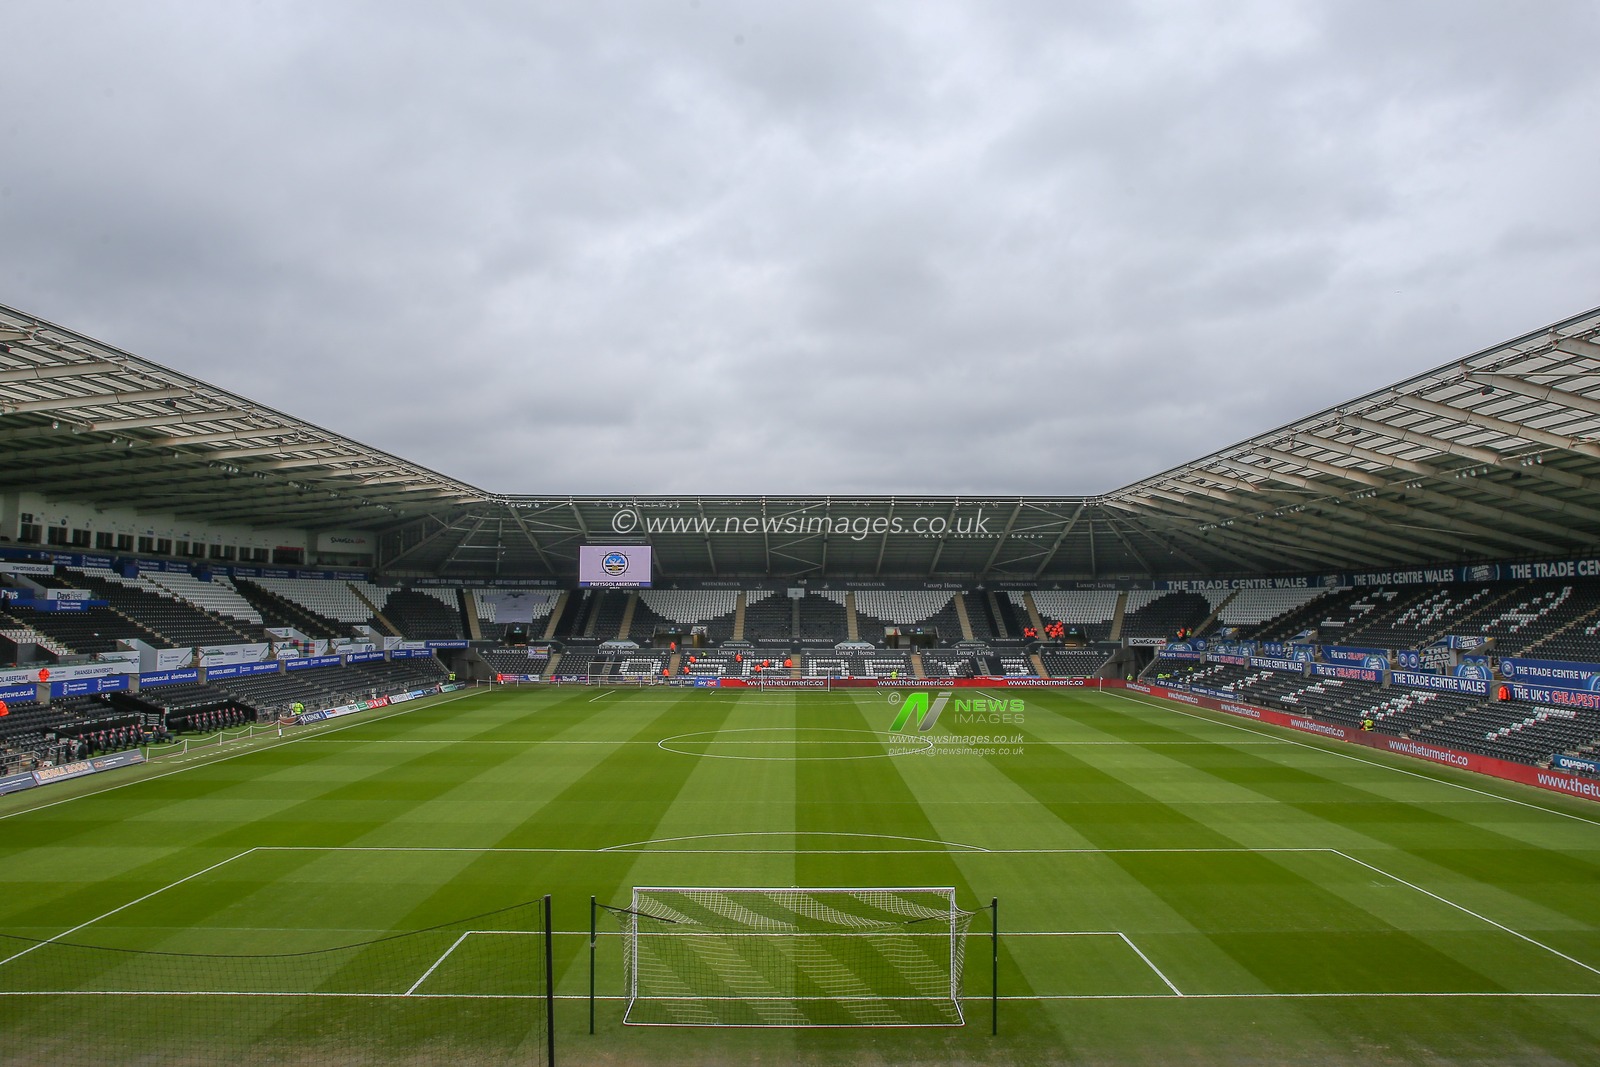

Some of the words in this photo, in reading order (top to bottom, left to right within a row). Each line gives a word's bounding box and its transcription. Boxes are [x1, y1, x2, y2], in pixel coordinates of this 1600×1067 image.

[1353, 575, 1366, 586] THE
[1368, 573, 1391, 585] TRADE
[1393, 571, 1423, 584] CENTRE
[1424, 569, 1454, 582] WALES
[1510, 564, 1531, 578] THE
[1534, 561, 1574, 577] TRADE
[1167, 580, 1188, 590] THE
[1191, 580, 1228, 590] TRADE
[1232, 579, 1272, 589] CENTRE
[1275, 577, 1308, 588] WALES
[1272, 660, 1287, 669] CENTRE
[1288, 662, 1302, 671] WALES
[1516, 666, 1528, 675] THE
[1529, 667, 1551, 676] TRADE
[1552, 669, 1579, 679] CENTRE
[1361, 670, 1376, 681] CARS
[1393, 673, 1406, 684] THE
[1407, 674, 1429, 686] TRADE
[1430, 677, 1458, 690] CENTRE
[1459, 680, 1486, 693] WALES
[1513, 688, 1529, 699] THE
[1531, 689, 1550, 702] UK'S
[1552, 691, 1600, 708] CHEAPEST
[1221, 704, 1260, 718] www.theturmeric.co
[1290, 718, 1345, 738] www.theturmeric.co
[1389, 740, 1468, 766] www.theturmeric.co
[38, 766, 67, 780] ROMA
[66, 762, 88, 774] 2000
[1560, 758, 1595, 772] owens
